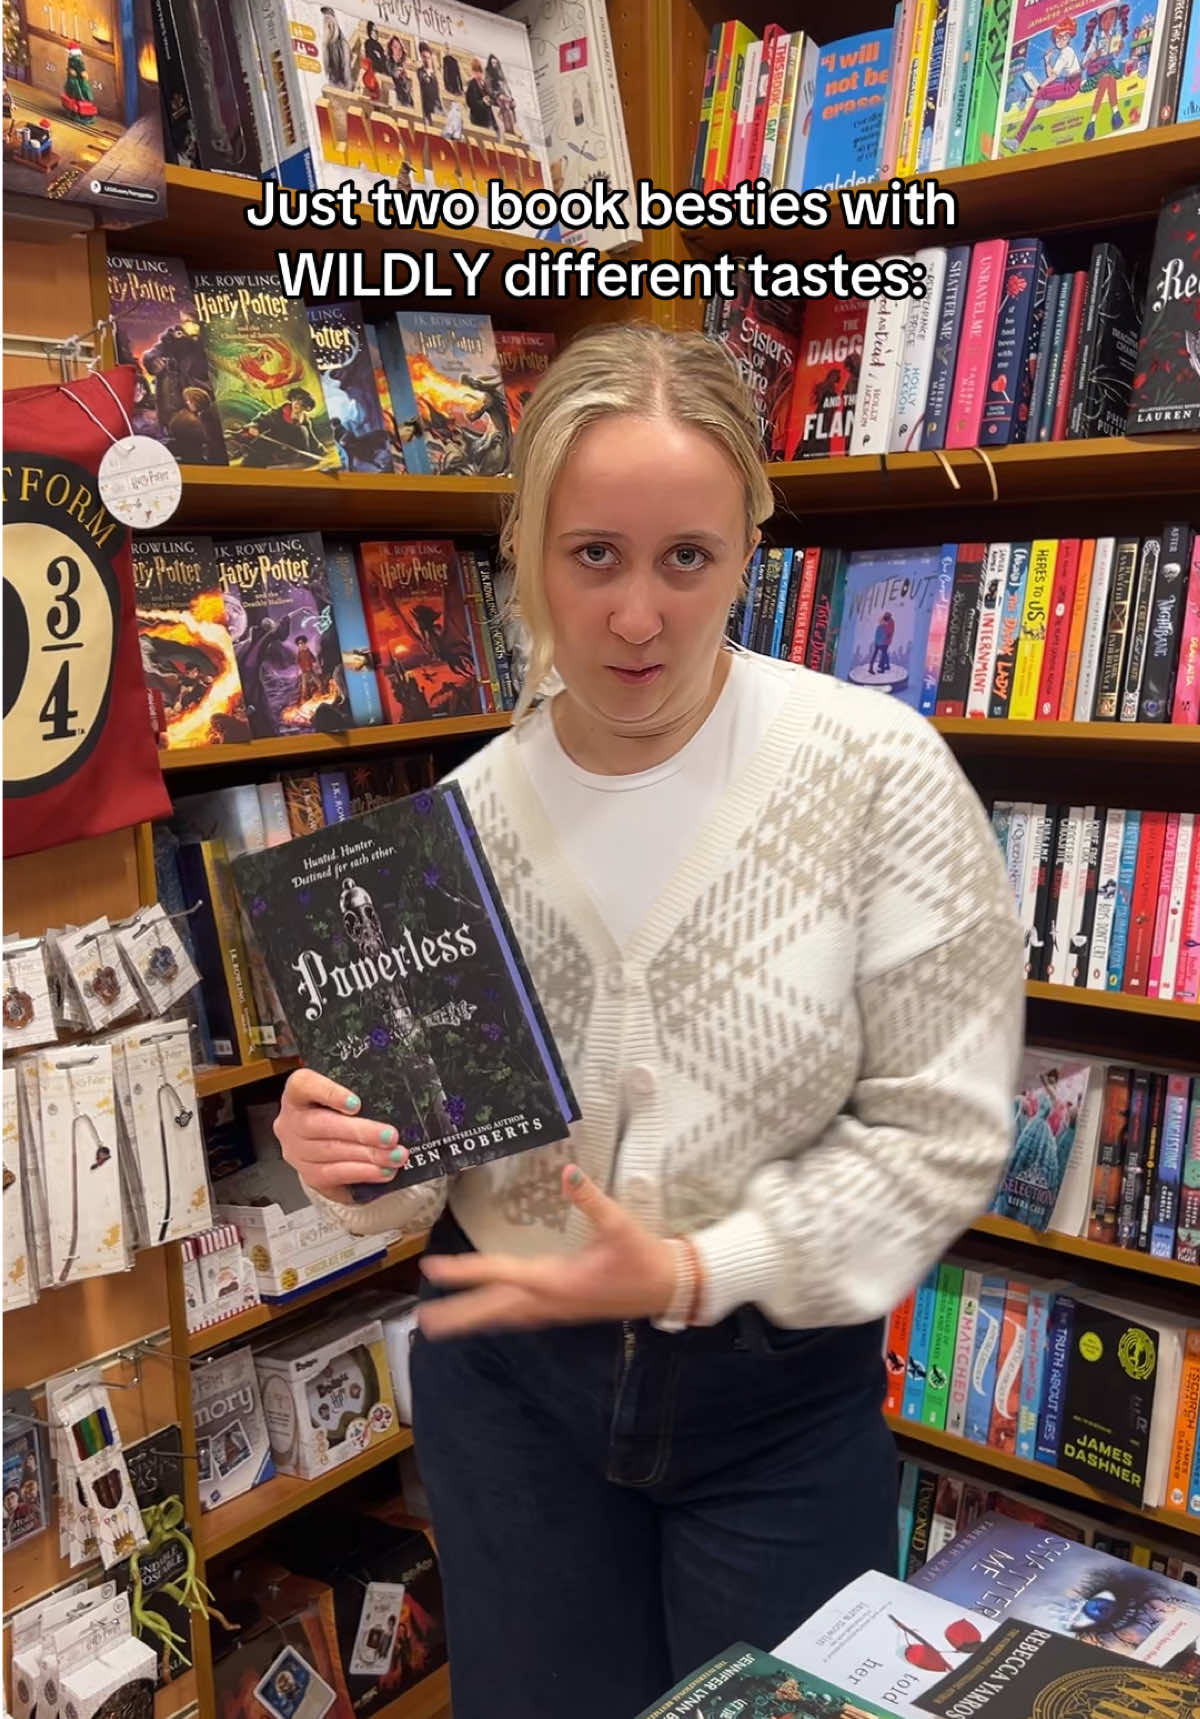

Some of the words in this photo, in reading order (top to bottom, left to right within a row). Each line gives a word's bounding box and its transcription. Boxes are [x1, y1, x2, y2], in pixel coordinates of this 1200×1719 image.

[839, 40, 881, 69] will
[825, 71, 859, 97] not
[863, 67, 888, 87] be
[765, 118, 777, 142] GAY
[106, 256, 168, 273] ROWLING
[216, 274, 281, 288] ROWLING
[128, 272, 176, 303] Potter
[944, 260, 961, 321] SHATTER
[973, 255, 993, 319] UNRAVEL
[1152, 258, 1200, 312] Re
[194, 291, 238, 323] Harry
[237, 289, 289, 323] Potter
[739, 315, 794, 370] Sisters
[822, 394, 842, 410] AND
[898, 361, 913, 415] JACKSON
[907, 367, 920, 406] HOLLY
[934, 370, 948, 416] TAHEREH
[1137, 409, 1192, 423] LAUREN
[131, 541, 195, 554] ROWLING
[235, 539, 303, 556] ROWLING
[153, 555, 200, 590] Potter
[218, 562, 259, 593] Harry
[257, 555, 310, 590] Potter
[379, 561, 414, 589] Harry
[412, 558, 449, 585] Potter
[46, 555, 82, 640] 3
[1033, 586, 1044, 598] TO
[972, 613, 995, 695] INTERNMENT
[993, 662, 1012, 700] LADY
[38, 660, 80, 741] 4
[291, 864, 332, 889] Destined
[334, 862, 348, 880] for
[350, 853, 370, 868] each
[371, 845, 398, 862] other.
[340, 839, 376, 858] Hunter.
[292, 921, 479, 1022] Powerless
[403, 1147, 441, 1171] REN
[449, 1117, 543, 1157] ROBERTS
[421, 1139, 442, 1151] COPY
[442, 1122, 494, 1146] BESTSELLING
[493, 1113, 526, 1130] AUTHOR
[955, 1315, 973, 1404] MATCHED
[1053, 1328, 1069, 1369] TRUTH
[1047, 1370, 1063, 1414] ABOUT
[1042, 1414, 1057, 1441] LIES
[1063, 1442, 1143, 1489] DASHNER
[1076, 1433, 1133, 1467] JAMES
[974, 1536, 1072, 1621] SHATTER
[703, 1652, 756, 1691] JENNIFER
[849, 1658, 885, 1686] her
[996, 1629, 1053, 1682] REBECCA
[675, 1687, 709, 1715] LYNN
[881, 1672, 921, 1706] told
[944, 1677, 1004, 1719] YARROS
